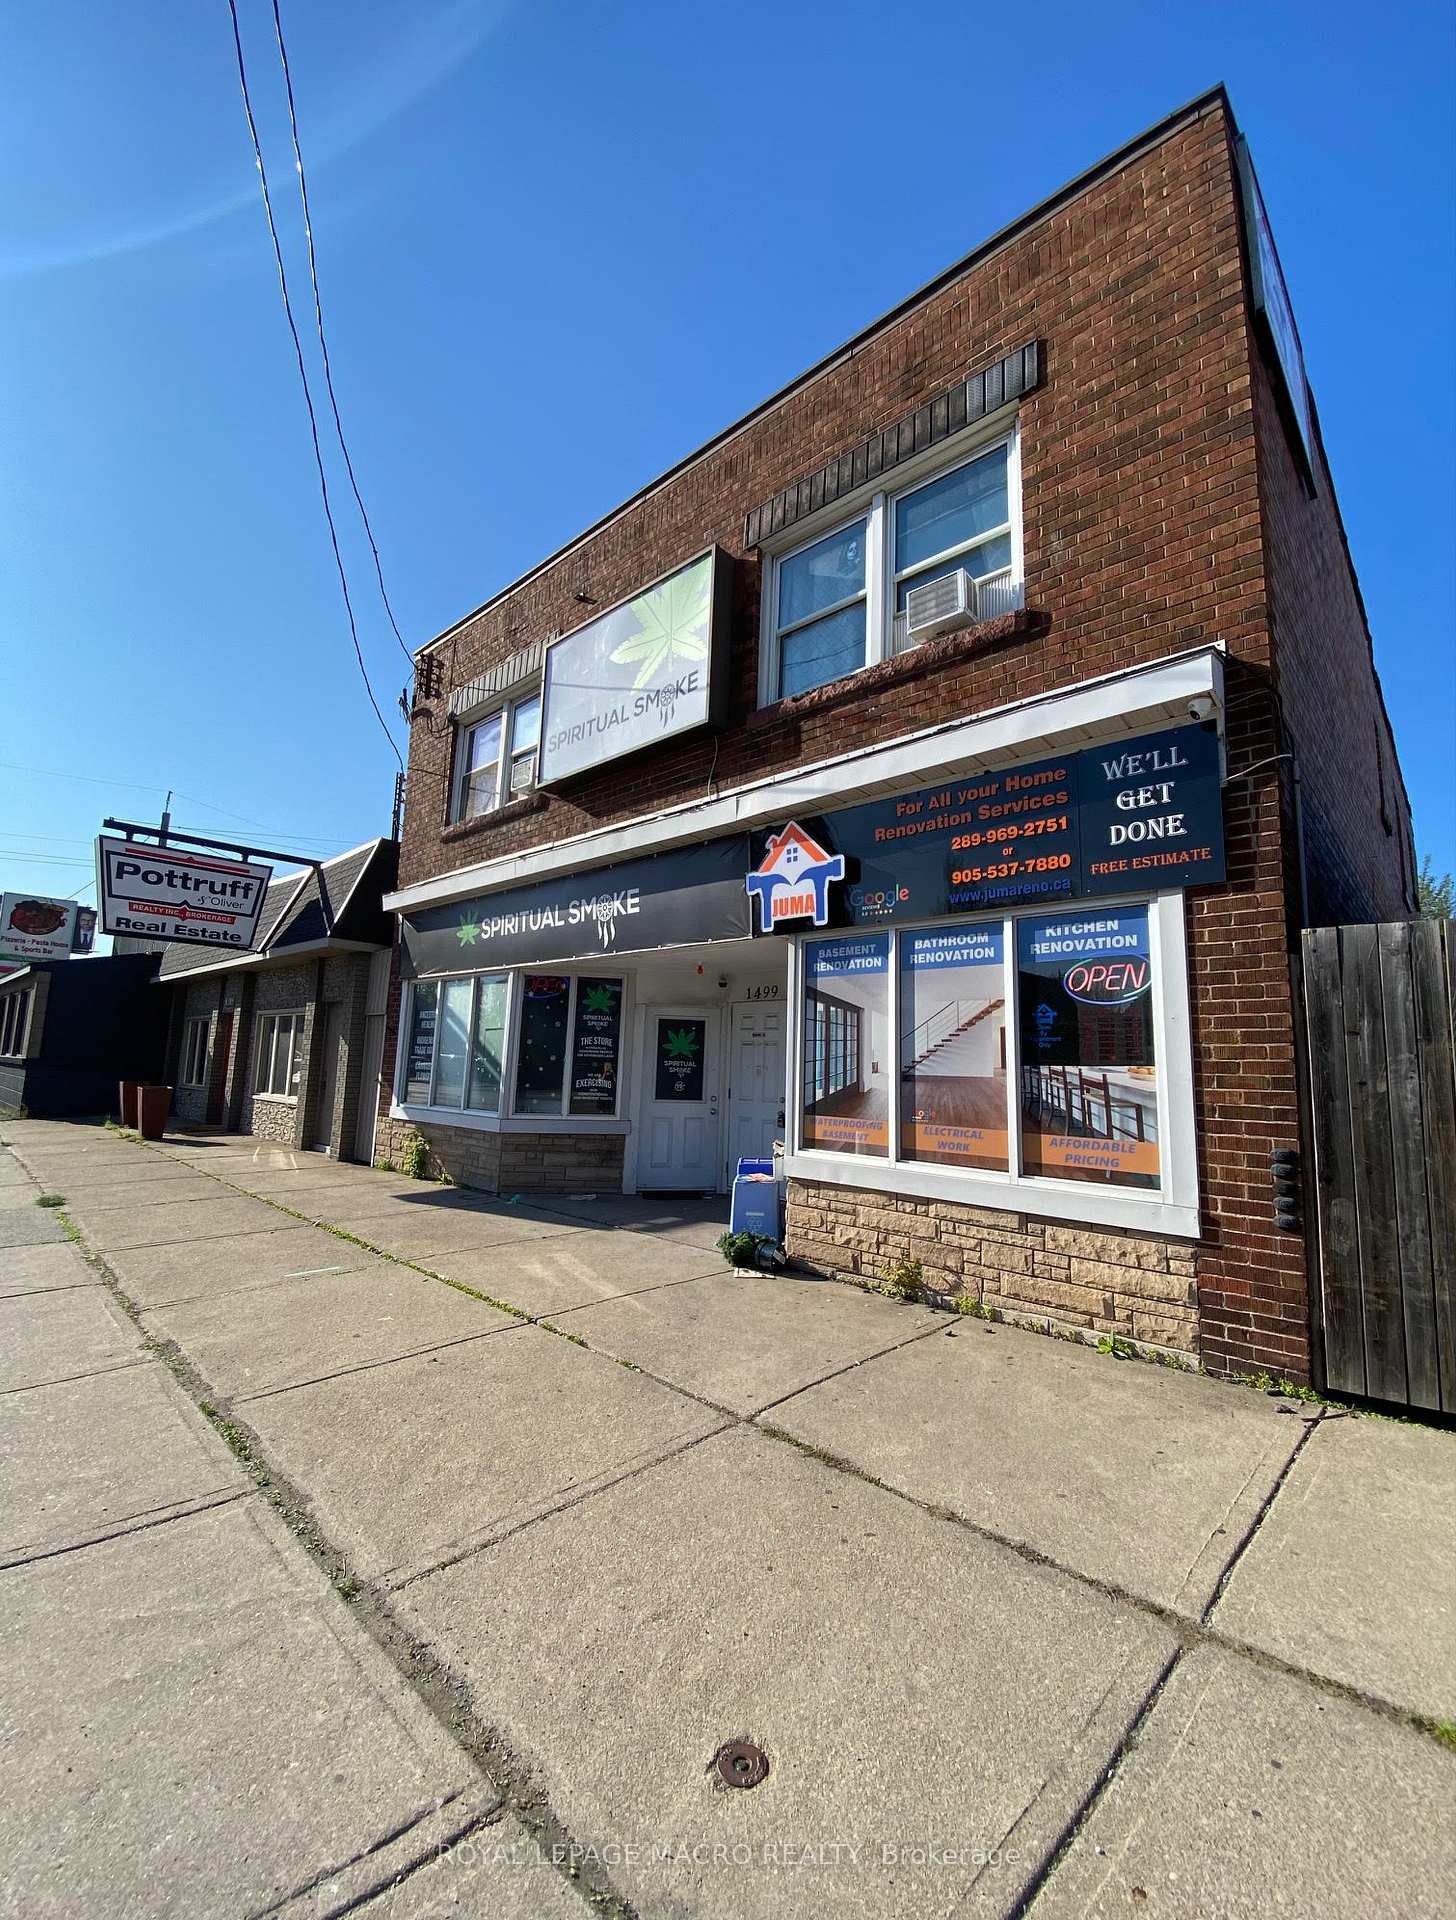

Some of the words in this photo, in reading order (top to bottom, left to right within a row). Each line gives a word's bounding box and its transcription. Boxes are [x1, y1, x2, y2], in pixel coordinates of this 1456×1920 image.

[549, 705, 630, 753] SPIRITUAL
[633, 669, 699, 718] SMOKE
[1101, 746, 1189, 781] WE'LL
[896, 802, 923, 817] For
[928, 792, 952, 810] All
[958, 782, 999, 805] your
[1005, 768, 1067, 792] Home
[1116, 781, 1176, 811] GET
[874, 809, 972, 842] Renovation
[977, 791, 1069, 821] Services
[951, 815, 1069, 850] 289-969-2751
[1109, 813, 1188, 846] DONE
[1002, 846, 1014, 856] or
[1090, 859, 1128, 875] FREE
[1132, 847, 1212, 869] ESTIMATE
[951, 854, 1071, 884] 905-537-7880
[115, 861, 254, 900] Pottruff
[949, 878, 1071, 904] www.jumareno.ca
[210, 896, 245, 909] Oliver
[772, 893, 816, 917] JUMA
[850, 883, 910, 907] Google
[132, 903, 165, 915] REALTY
[185, 910, 233, 923] BROKERAGE
[480, 903, 565, 939] SPIRITUAL
[568, 888, 641, 925] SMOKE
[115, 916, 167, 933] Real
[174, 924, 242, 942] Estate
[1045, 919, 1119, 937] KITCHEN
[818, 944, 876, 959] BASEMENT
[914, 932, 989, 950] BATHROOM
[1030, 934, 1138, 955] RENOVATION
[813, 957, 882, 972] RENOVATION
[910, 947, 995, 964] RENOVATION
[1068, 962, 1147, 992] OPEN
[746, 985, 779, 1000] 1499
[581, 1037, 593, 1046] THE
[593, 1036, 613, 1047] STORE
[664, 1060, 697, 1068] SPIRITUAL
[822, 1129, 869, 1141] BASEMENT
[923, 1125, 985, 1139] ELECTRICAL
[937, 1140, 970, 1152] WORK
[1049, 1137, 1137, 1154] AFFORDABLE
[1064, 1153, 1121, 1168] PRICING
